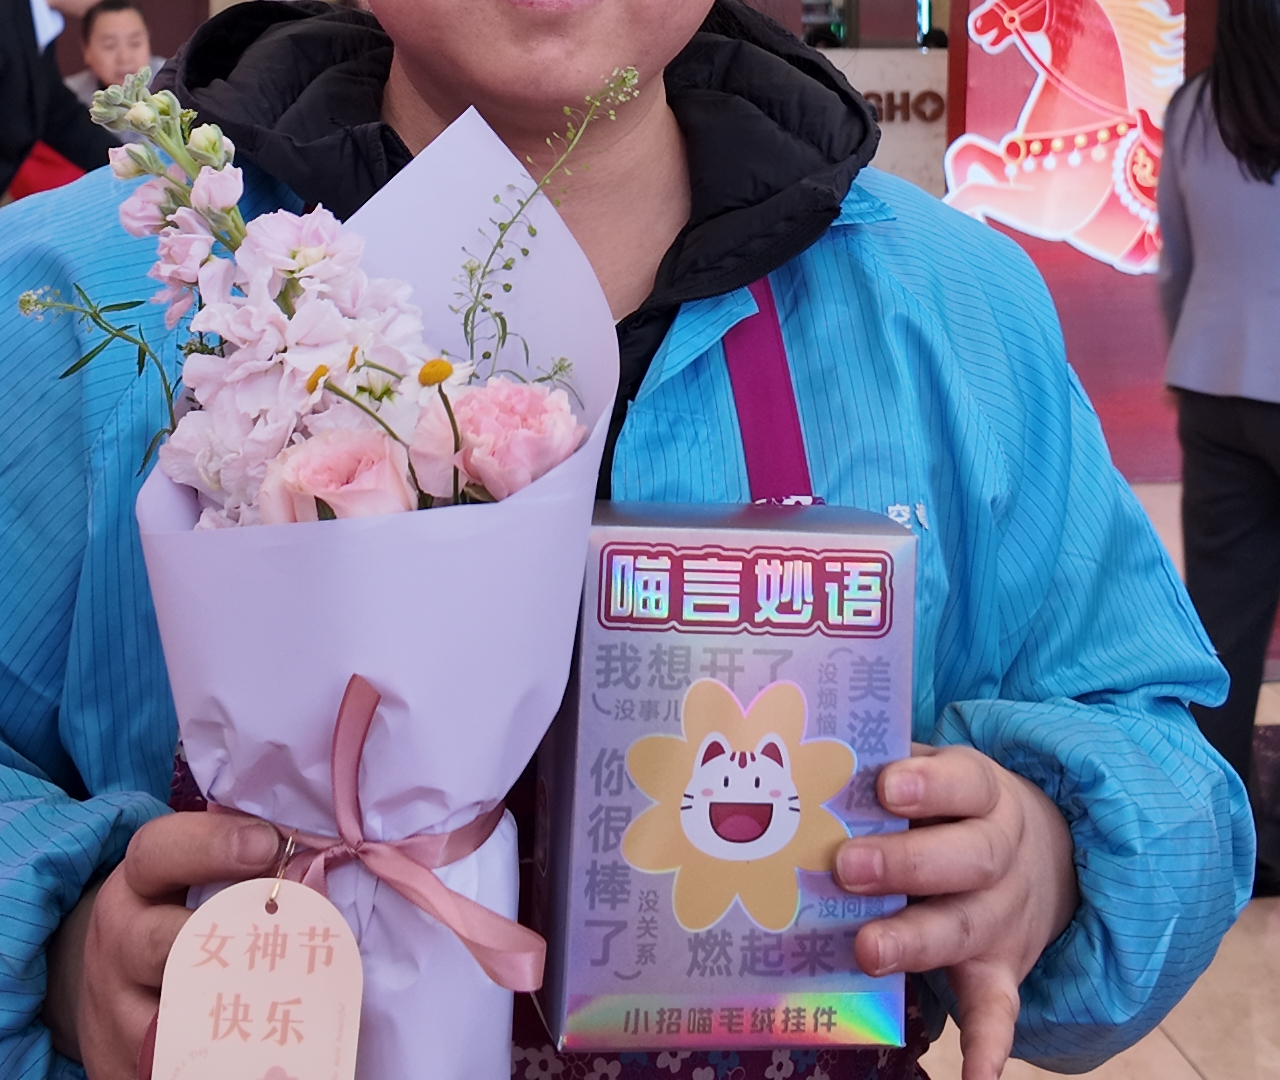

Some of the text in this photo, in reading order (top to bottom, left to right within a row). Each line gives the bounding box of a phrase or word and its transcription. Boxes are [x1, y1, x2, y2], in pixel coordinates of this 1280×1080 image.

[609, 554, 883, 627] 喵言妙语
[594, 641, 794, 691] 我想开了
[583, 747, 636, 967] 你很棒了
[190, 922, 341, 975] 女神节
[634, 889, 660, 966] 没关系
[208, 992, 305, 1046] 快乐
[622, 1005, 838, 1036] 小招喵毛绒挂件
